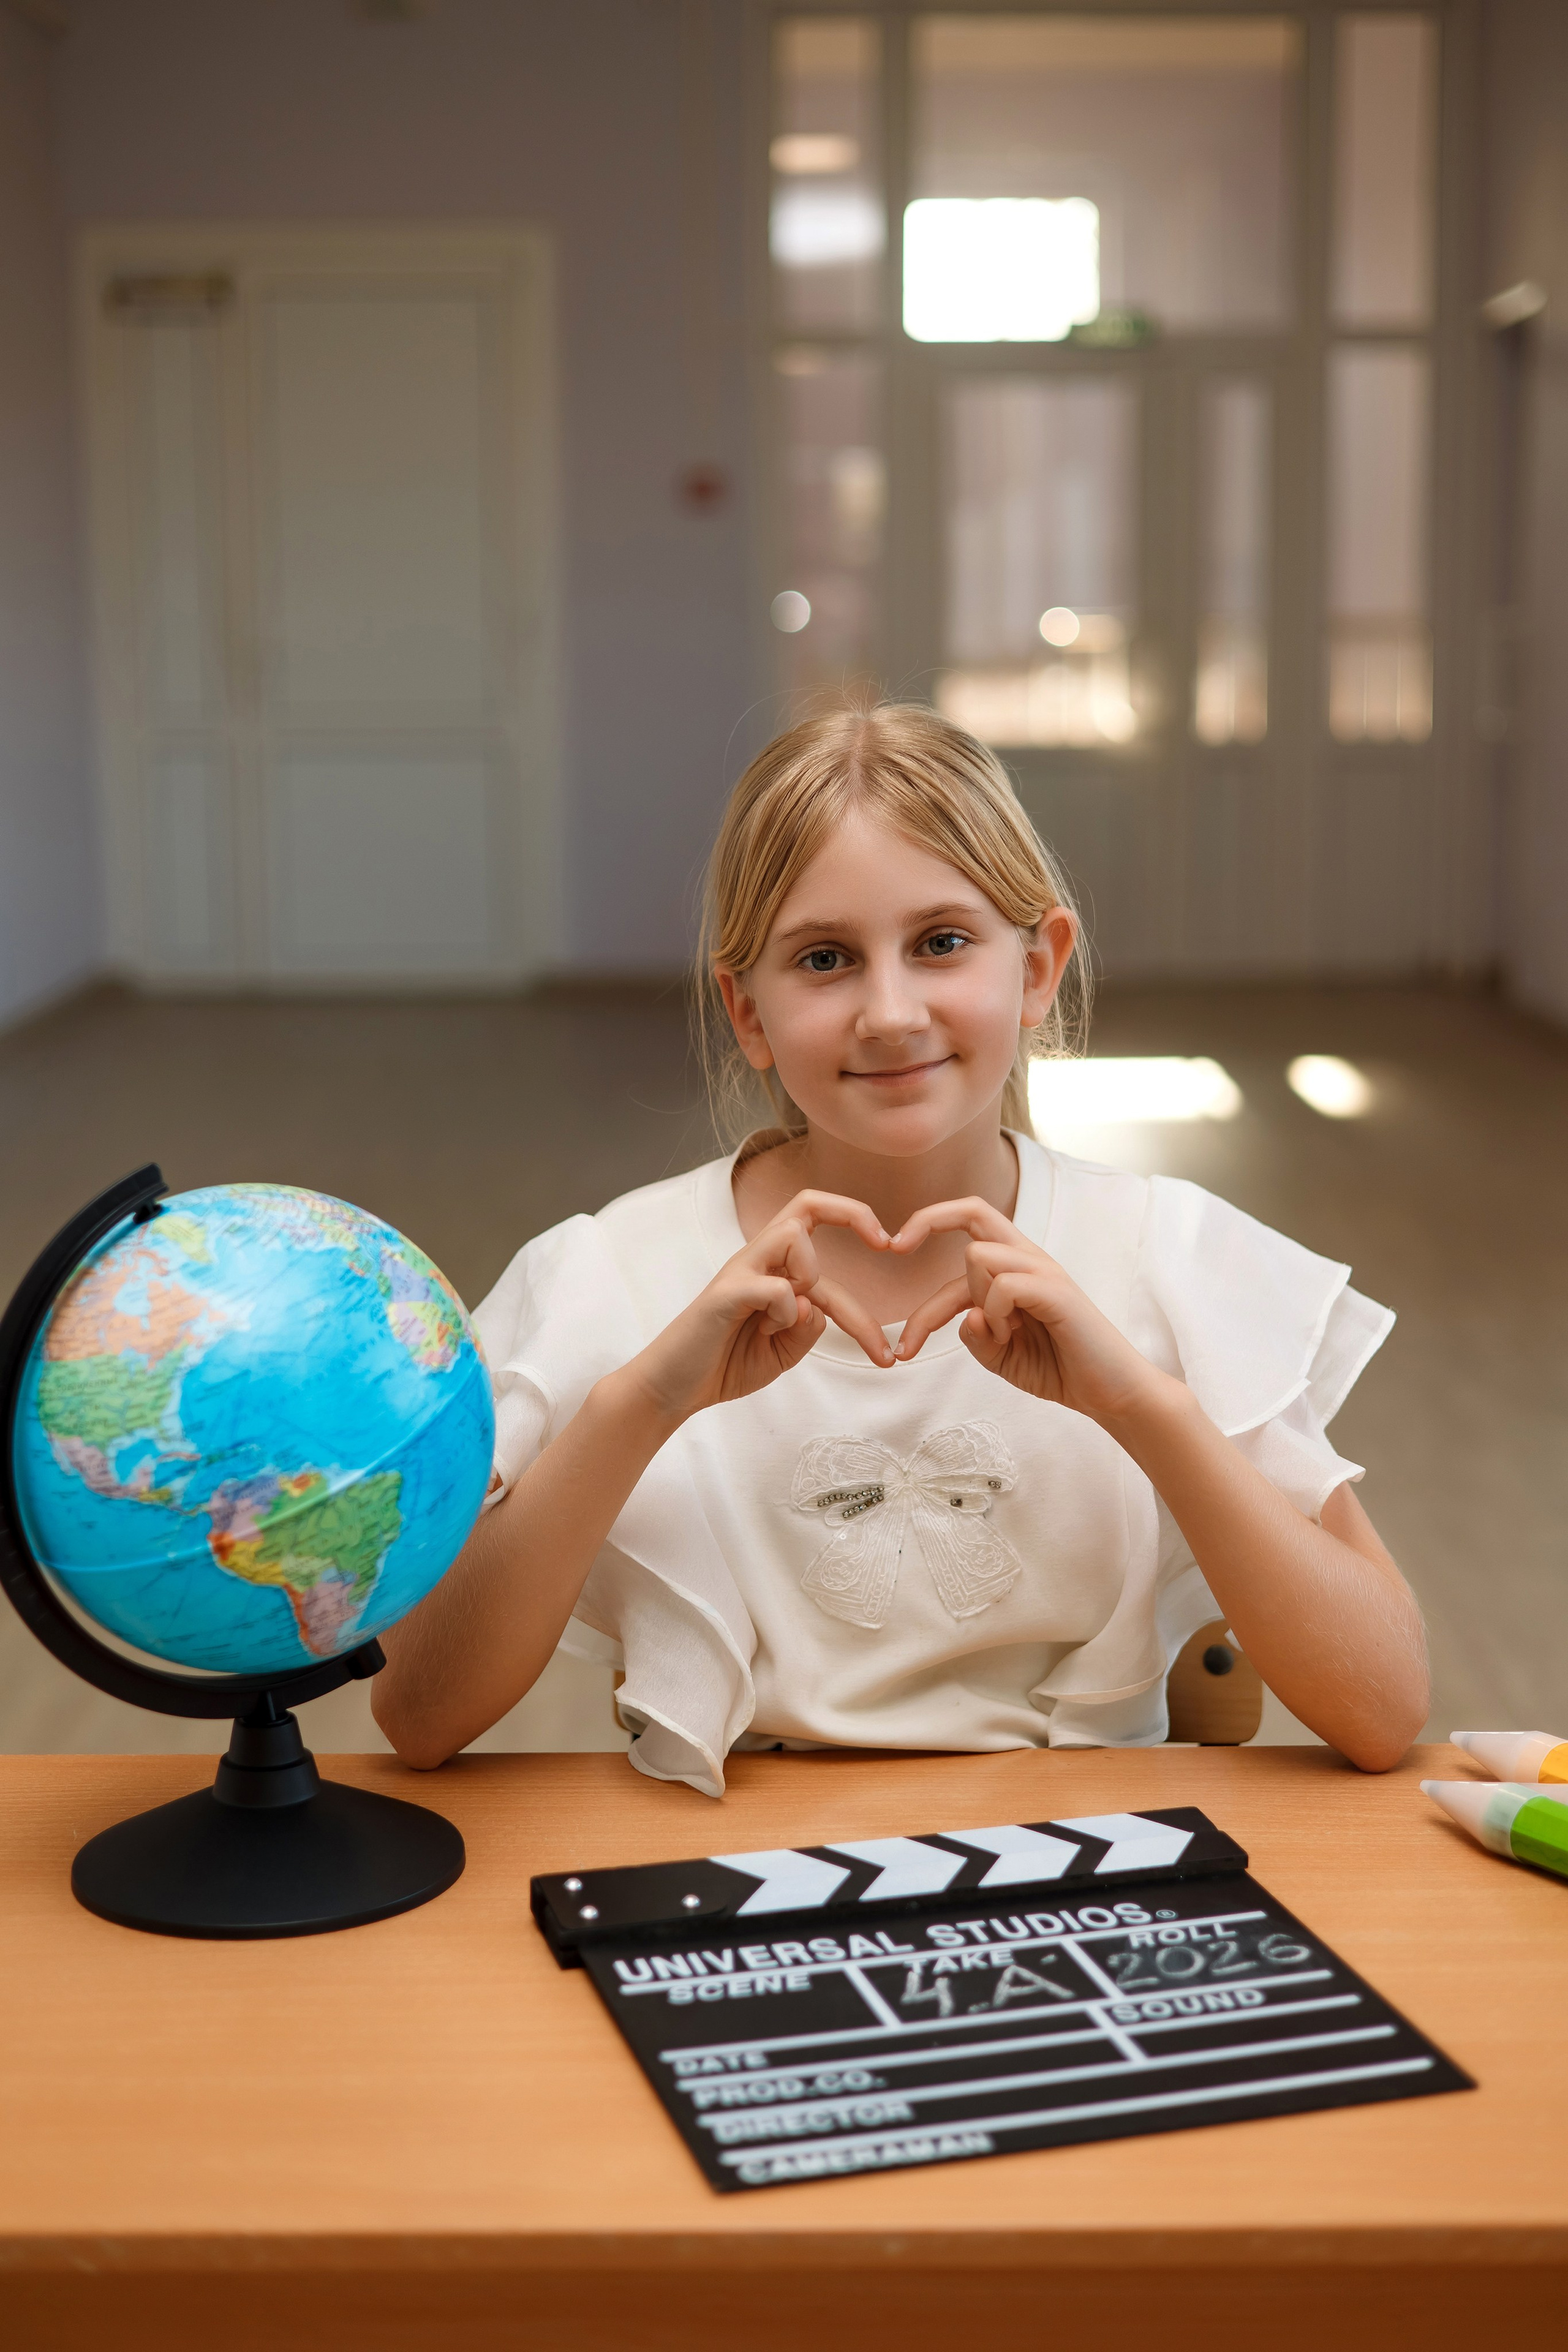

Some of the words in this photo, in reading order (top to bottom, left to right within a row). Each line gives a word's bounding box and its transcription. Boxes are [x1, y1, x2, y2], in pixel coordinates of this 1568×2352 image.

[1128, 1922, 1237, 1949] ROLL
[613, 1931, 914, 1983] UNIVERSAL
[904, 1948, 1014, 1975] TAKE
[1107, 1933, 1311, 1988] 2026
[667, 1972, 812, 2004] SCENE
[1112, 1988, 1265, 2023] SOUND
[675, 2052, 769, 2076] DATE
[712, 2101, 914, 2144] DIRECTOR
[737, 2132, 995, 2184] CAMERAMAN
